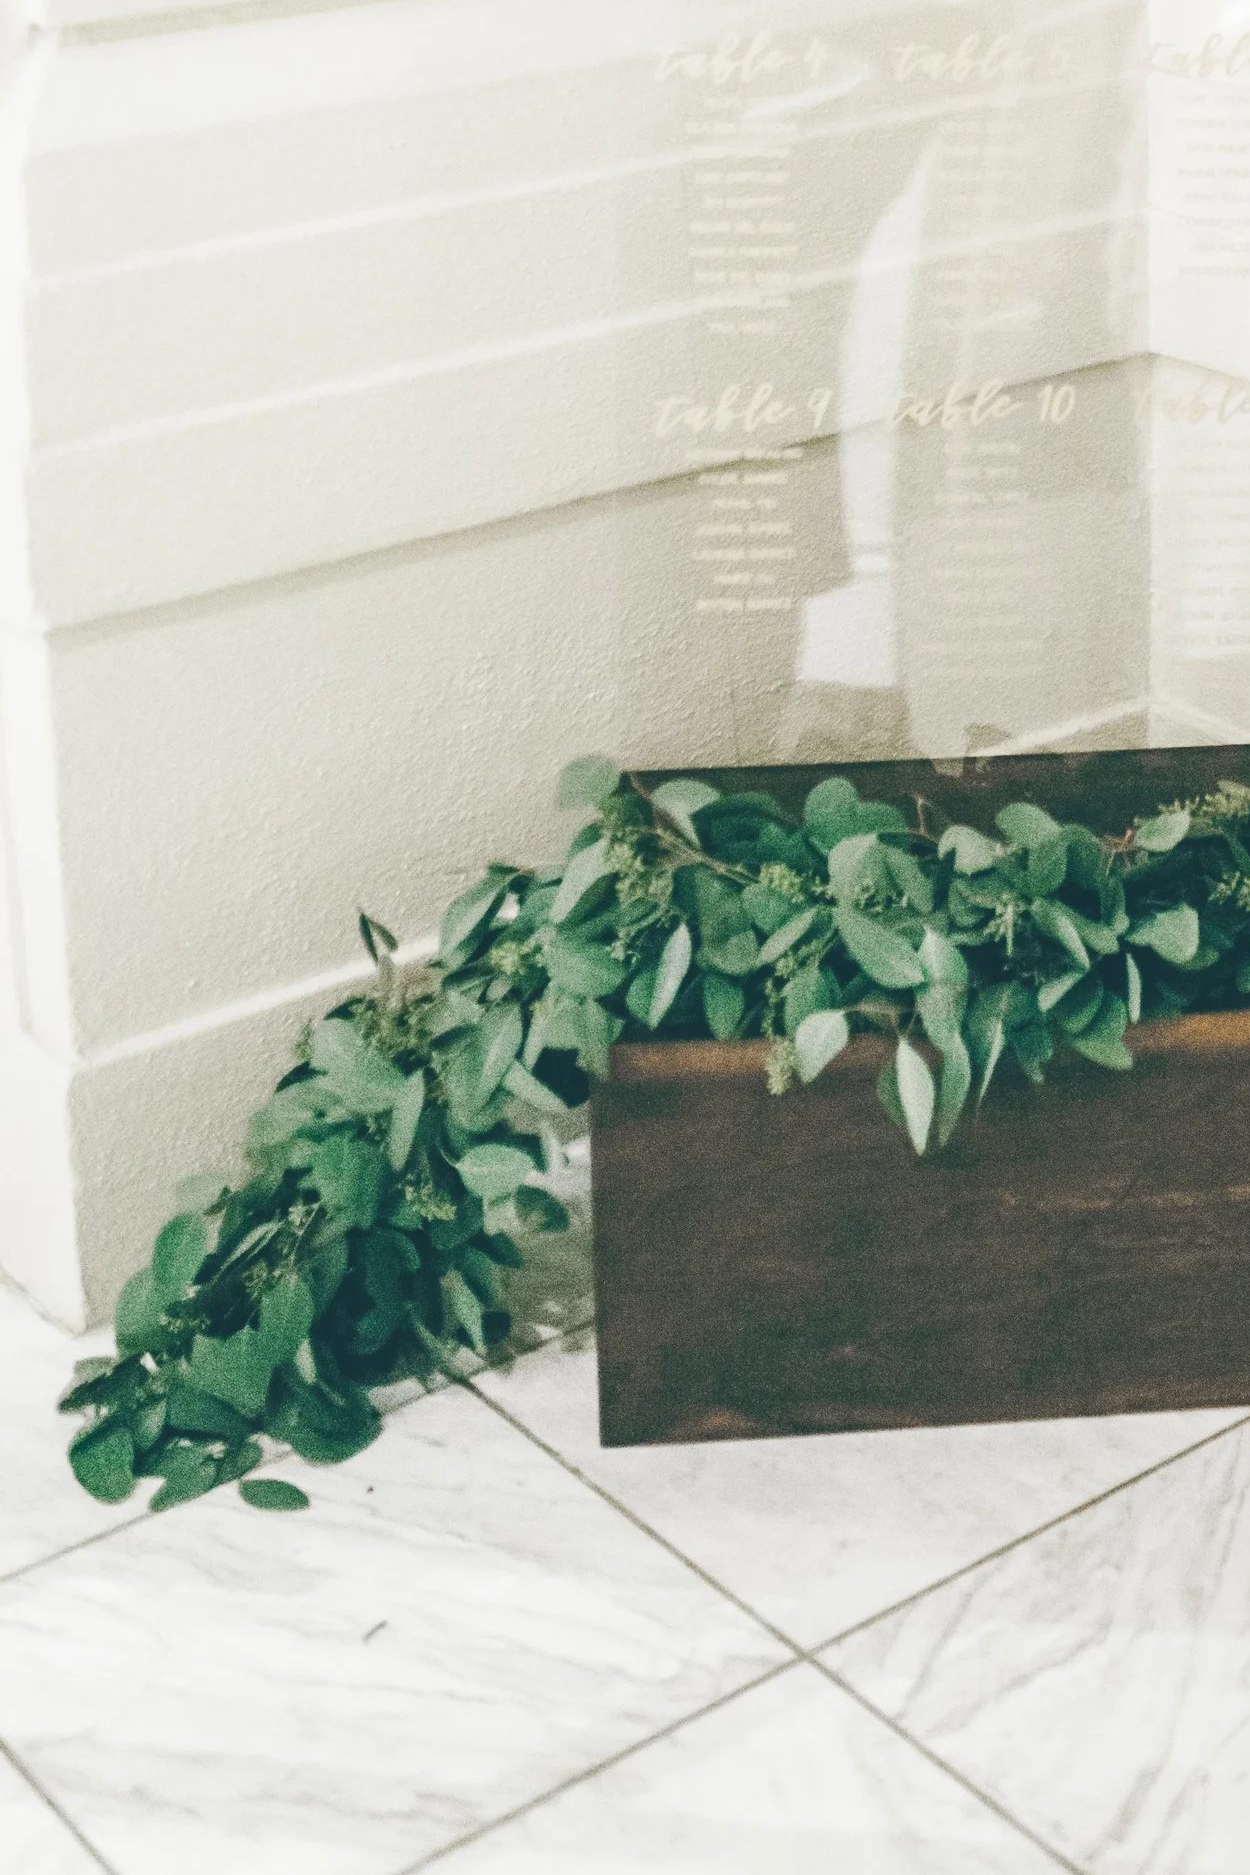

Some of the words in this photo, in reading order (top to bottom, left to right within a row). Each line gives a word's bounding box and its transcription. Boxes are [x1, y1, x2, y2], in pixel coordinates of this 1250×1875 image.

[654, 30, 795, 85] table
[655, 382, 797, 438] table
[808, 387, 833, 430] 9
[886, 378, 1024, 434] table
[1037, 384, 1076, 424] 10
